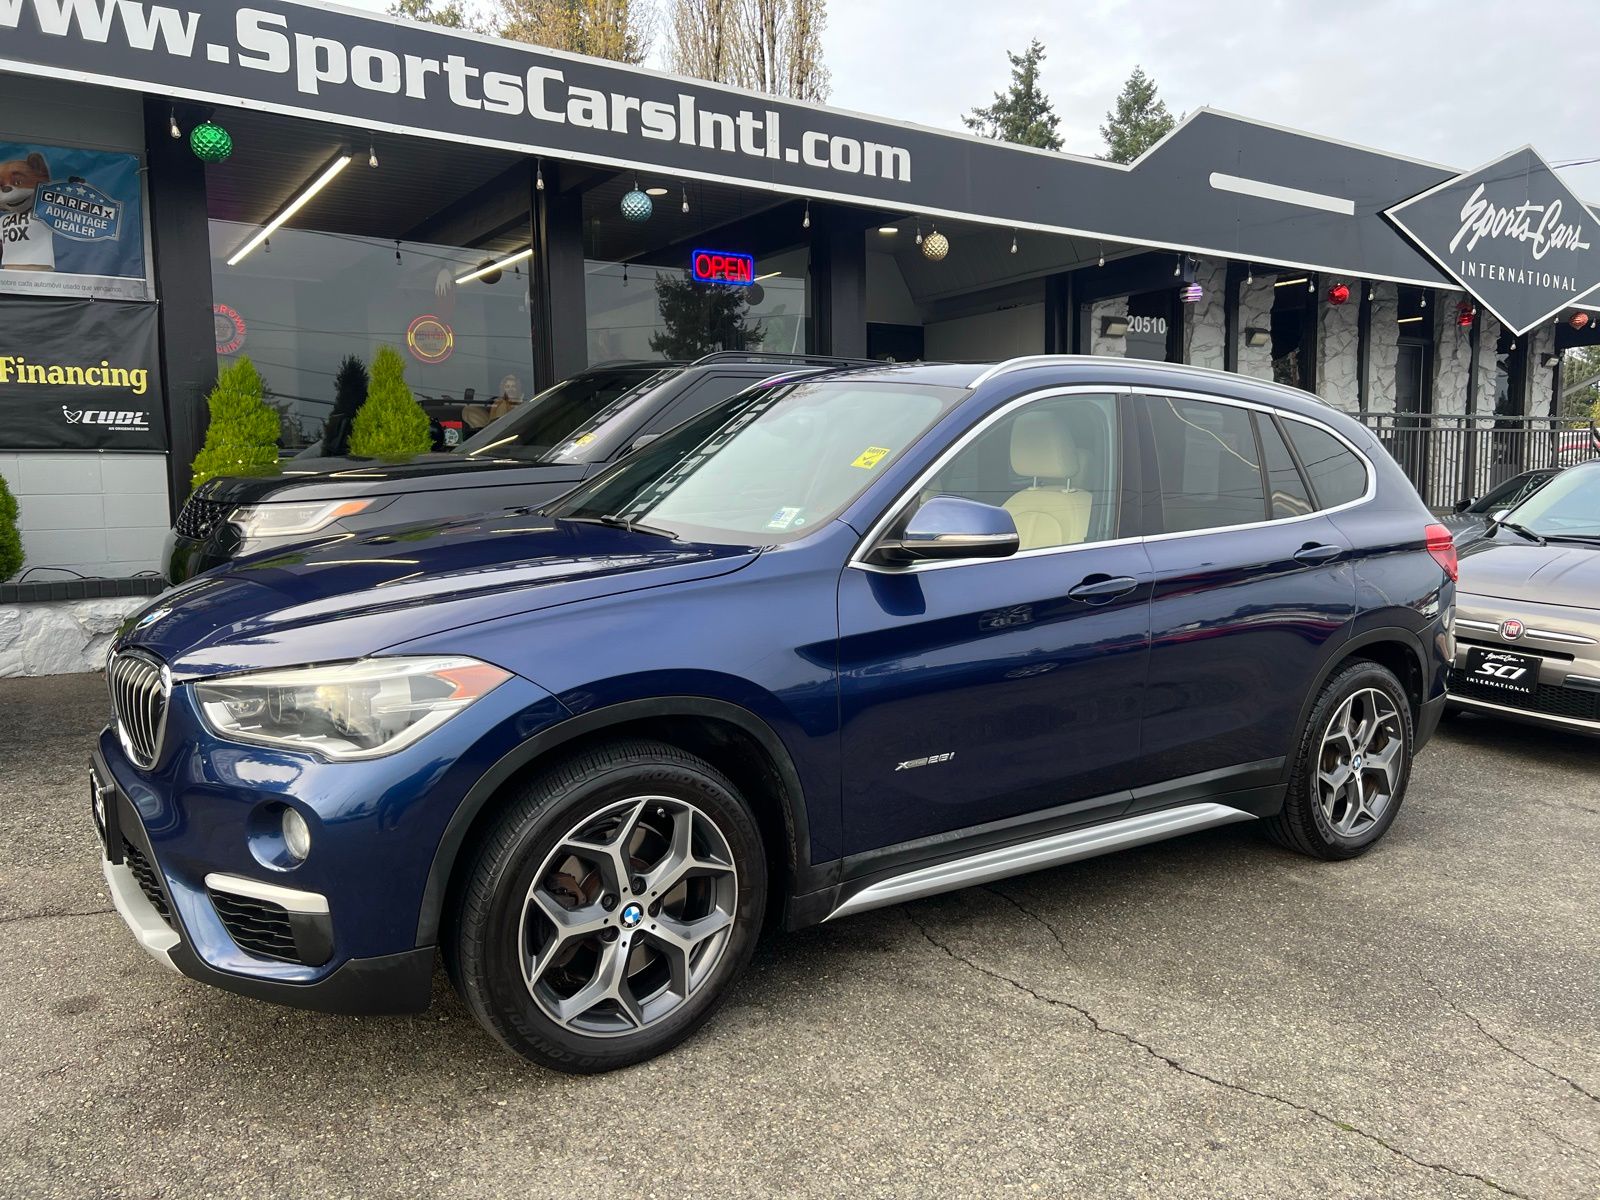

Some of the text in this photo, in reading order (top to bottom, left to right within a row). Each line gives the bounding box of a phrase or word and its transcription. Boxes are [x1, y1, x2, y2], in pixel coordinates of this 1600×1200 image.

[0, 0, 912, 182] ww.SportsCarsIntl.com
[42, 191, 115, 220] CARFAX
[2, 212, 30, 229] CAR
[46, 205, 108, 230] ADVANTAGE
[54, 219, 96, 238] DEALER
[1450, 182, 1590, 260] Sports Cars
[3, 226, 30, 243] FOX
[695, 254, 751, 282] OPEN
[1460, 260, 1577, 292] INTERNATIONAL
[1126, 315, 1167, 334] 20510
[0, 356, 148, 395] Financing
[81, 410, 150, 425] CUDL
[1474, 662, 1527, 680] SCI
[1466, 676, 1530, 693] INTERNATIONAL
